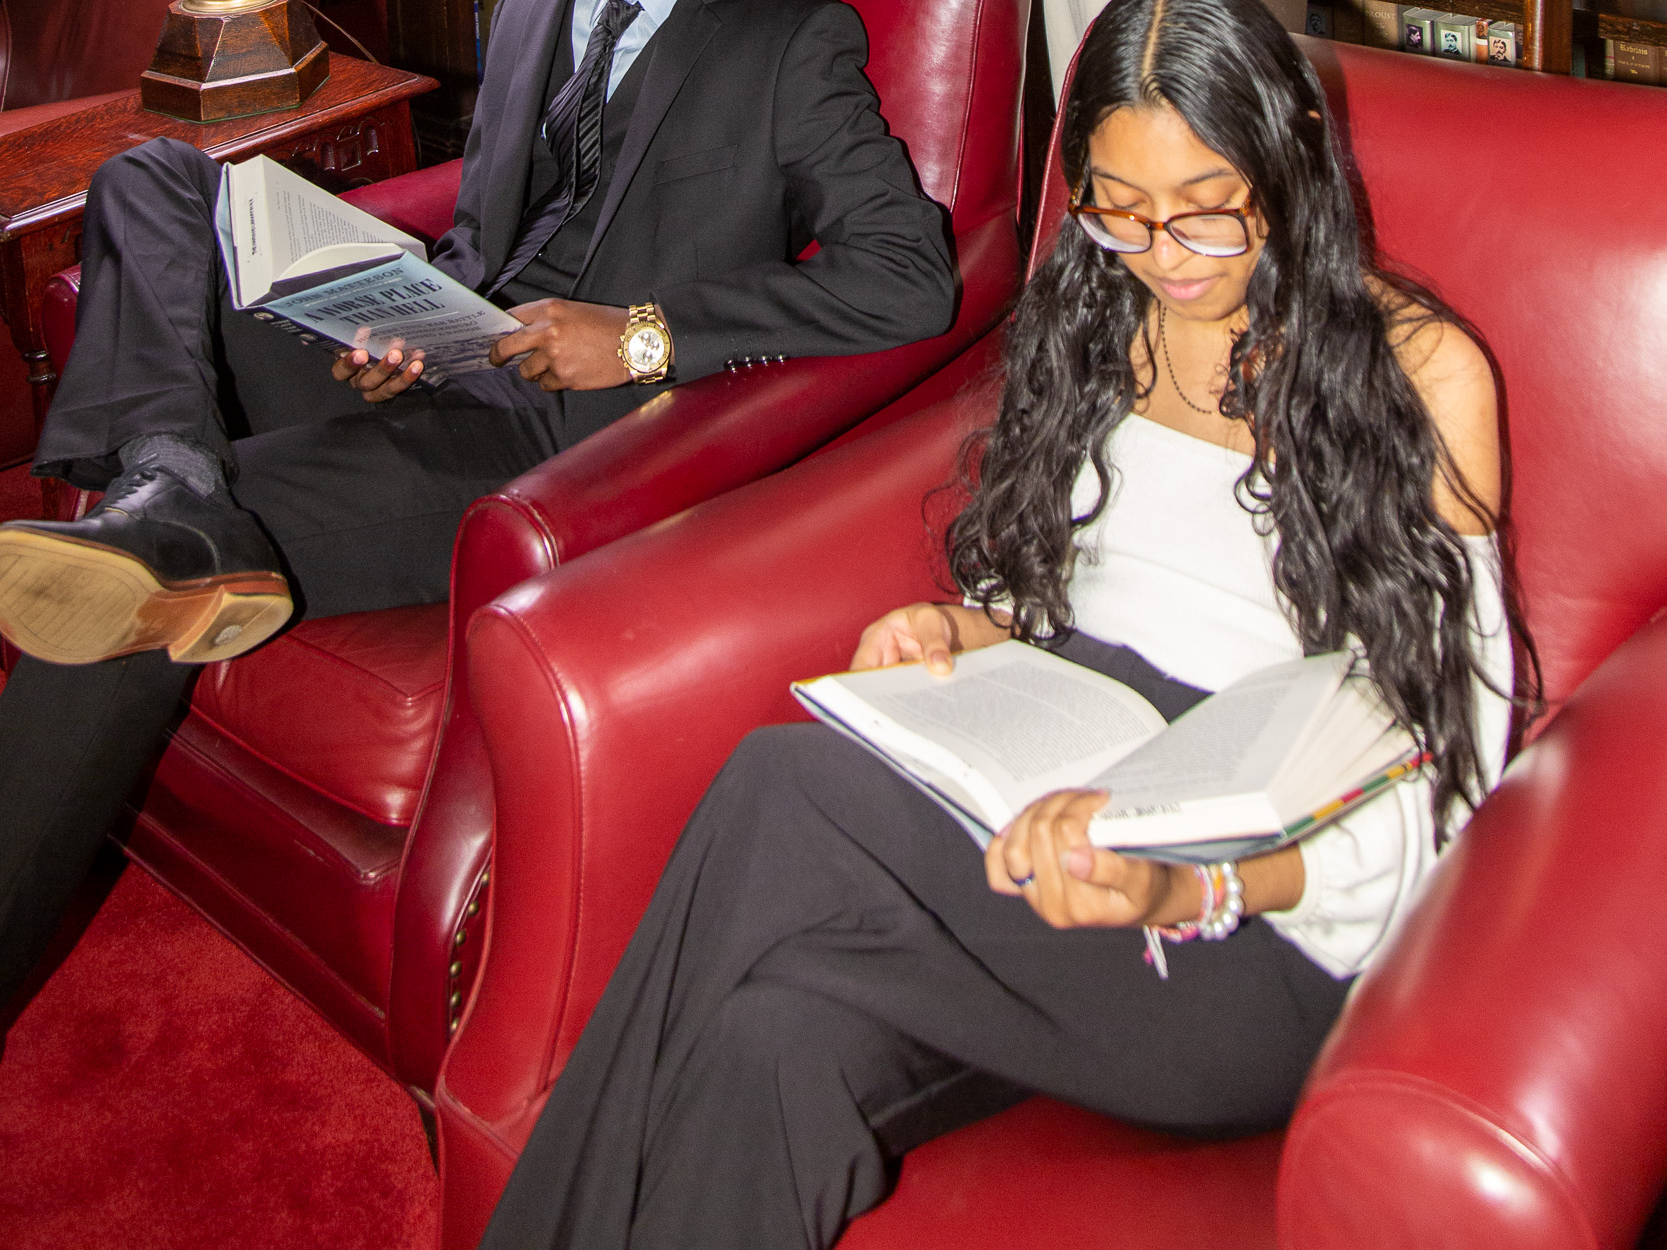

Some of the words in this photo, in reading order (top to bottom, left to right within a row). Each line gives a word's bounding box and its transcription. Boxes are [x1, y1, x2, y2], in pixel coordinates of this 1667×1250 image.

[1620, 44, 1648, 55] Rabelais
[287, 294, 318, 307] JOHN
[324, 267, 404, 296] MATTESON
[304, 310, 321, 324] A
[318, 292, 381, 319] WORSE
[381, 278, 443, 304] PLACE
[340, 308, 394, 326] THAN
[394, 298, 446, 318] HELL
[449, 310, 486, 324] BATTLE
